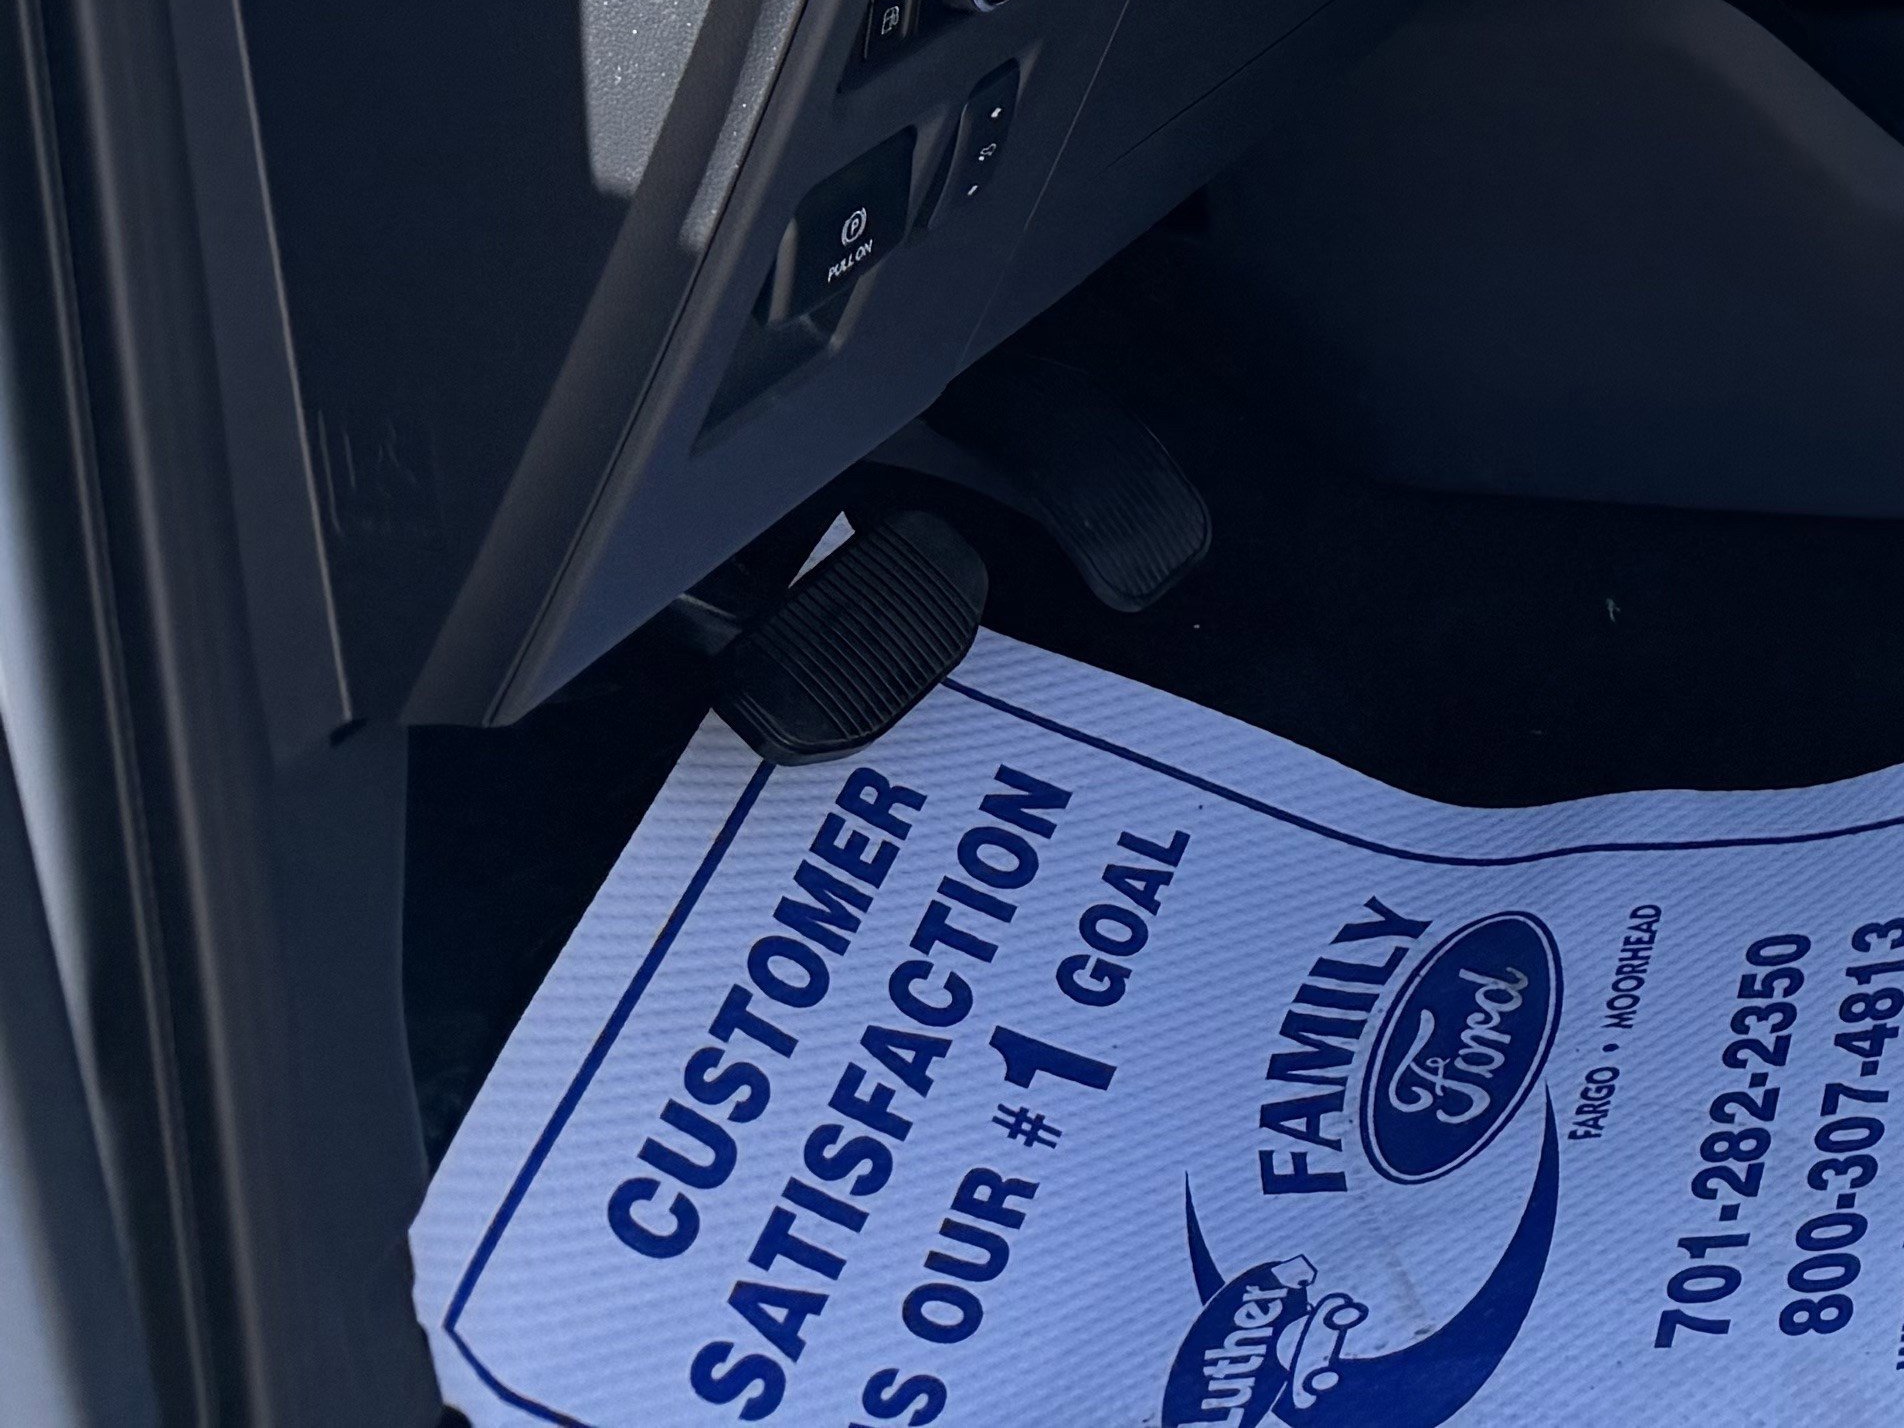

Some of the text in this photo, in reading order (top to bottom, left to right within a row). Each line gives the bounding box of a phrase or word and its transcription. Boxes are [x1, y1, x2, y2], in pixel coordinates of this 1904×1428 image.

[827, 238, 873, 283] PULL ON
[607, 766, 928, 1259] CUSTOMER
[690, 763, 1074, 1421] SATISFACTION
[848, 829, 1191, 1428] S OUR #1 GOAL
[1258, 895, 1434, 1196] FAMILY
[1388, 966, 1529, 1124] Ford
[1567, 904, 1662, 1141] FARGO MOORHEAD
[1654, 933, 1812, 1349] 701-282-2350
[1177, 1284, 1289, 1428] Luther
